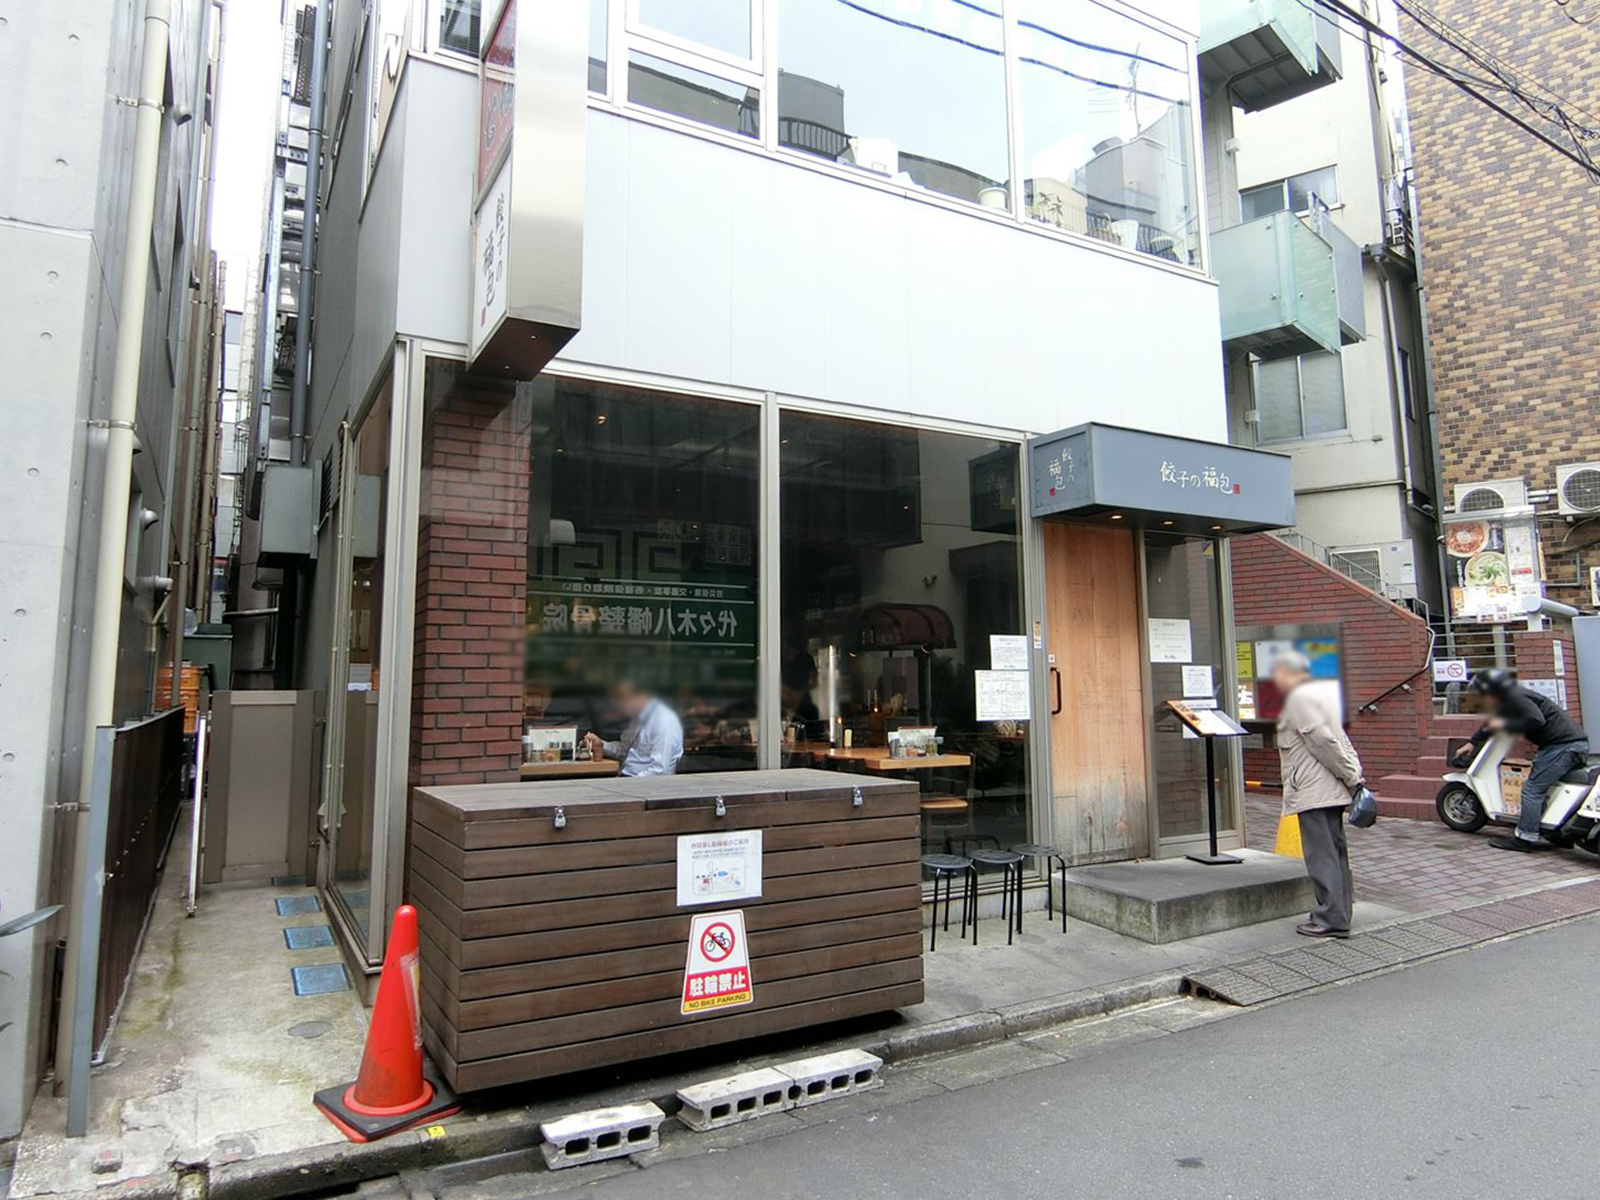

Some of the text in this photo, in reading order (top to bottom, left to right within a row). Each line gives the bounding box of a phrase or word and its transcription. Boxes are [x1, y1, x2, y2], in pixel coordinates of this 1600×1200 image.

[1160, 460, 1233, 494] 餃子の福包
[689, 971, 747, 997] 駐輪禁止
[688, 993, 746, 1009] NO BIKE PARKING
